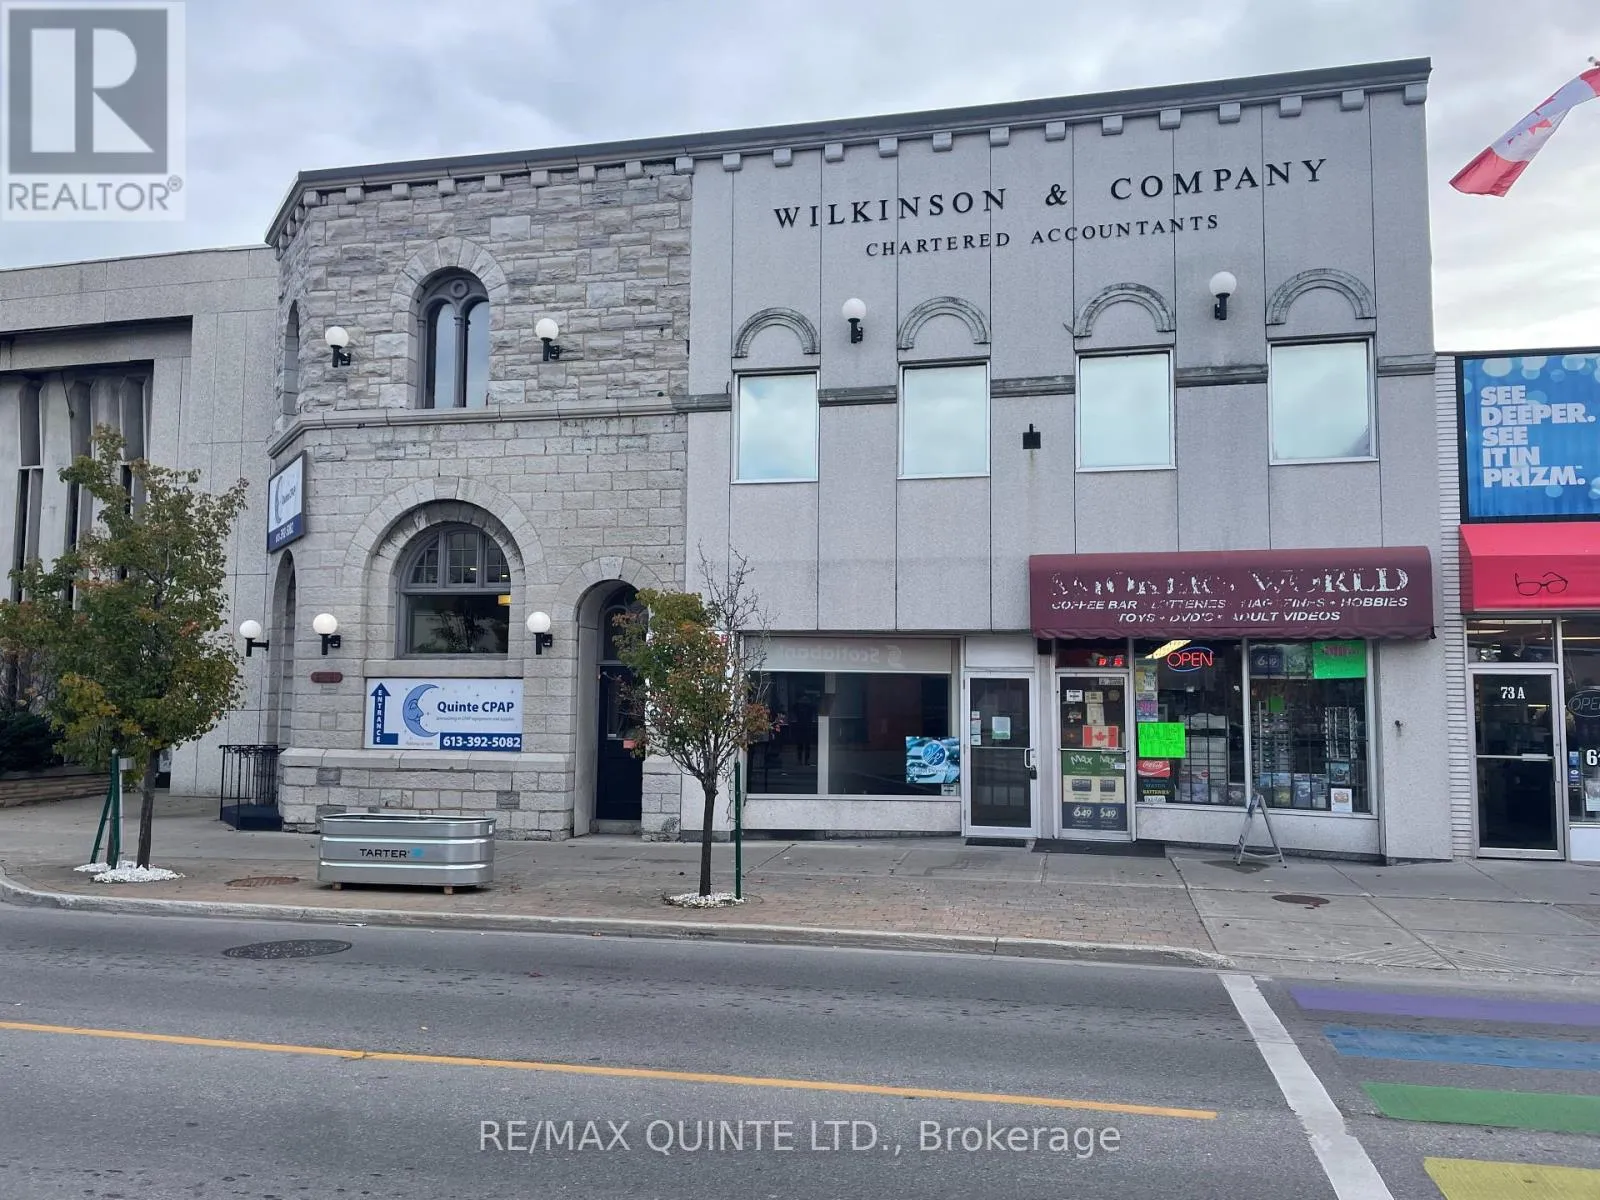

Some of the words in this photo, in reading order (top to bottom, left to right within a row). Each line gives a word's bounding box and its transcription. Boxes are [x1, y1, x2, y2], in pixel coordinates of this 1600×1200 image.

[774, 188, 1006, 228] WILKINSON
[1045, 184, 1068, 206] &
[1110, 158, 1327, 200] COMPANY
[866, 232, 1010, 256] CHARTERED
[1031, 214, 1219, 244] ACCOUNTANTS
[1480, 385, 1526, 405] SEE
[1481, 402, 1596, 426] DEEPER.
[1482, 426, 1528, 446] SEE
[1482, 447, 1507, 467] IT
[1509, 446, 1540, 466] IN
[1108, 601, 1138, 610] BAR
[1151, 600, 1226, 610] LTTERIES
[1240, 598, 1325, 609] MAGZINES
[1340, 597, 1409, 608] HOBBIES
[1118, 613, 1155, 623] TOYS
[1283, 611, 1341, 621] VIDEOS
[1168, 652, 1213, 667] OPEN
[1500, 687, 1516, 699] 73
[1517, 687, 1526, 699] A
[437, 701, 479, 713] Quinte
[481, 702, 515, 713] CPAP
[1571, 697, 1600, 711] OPE
[443, 736, 521, 748] 613-392-5082
[1070, 755, 1094, 766] MAX
[360, 848, 408, 859] TARTER
